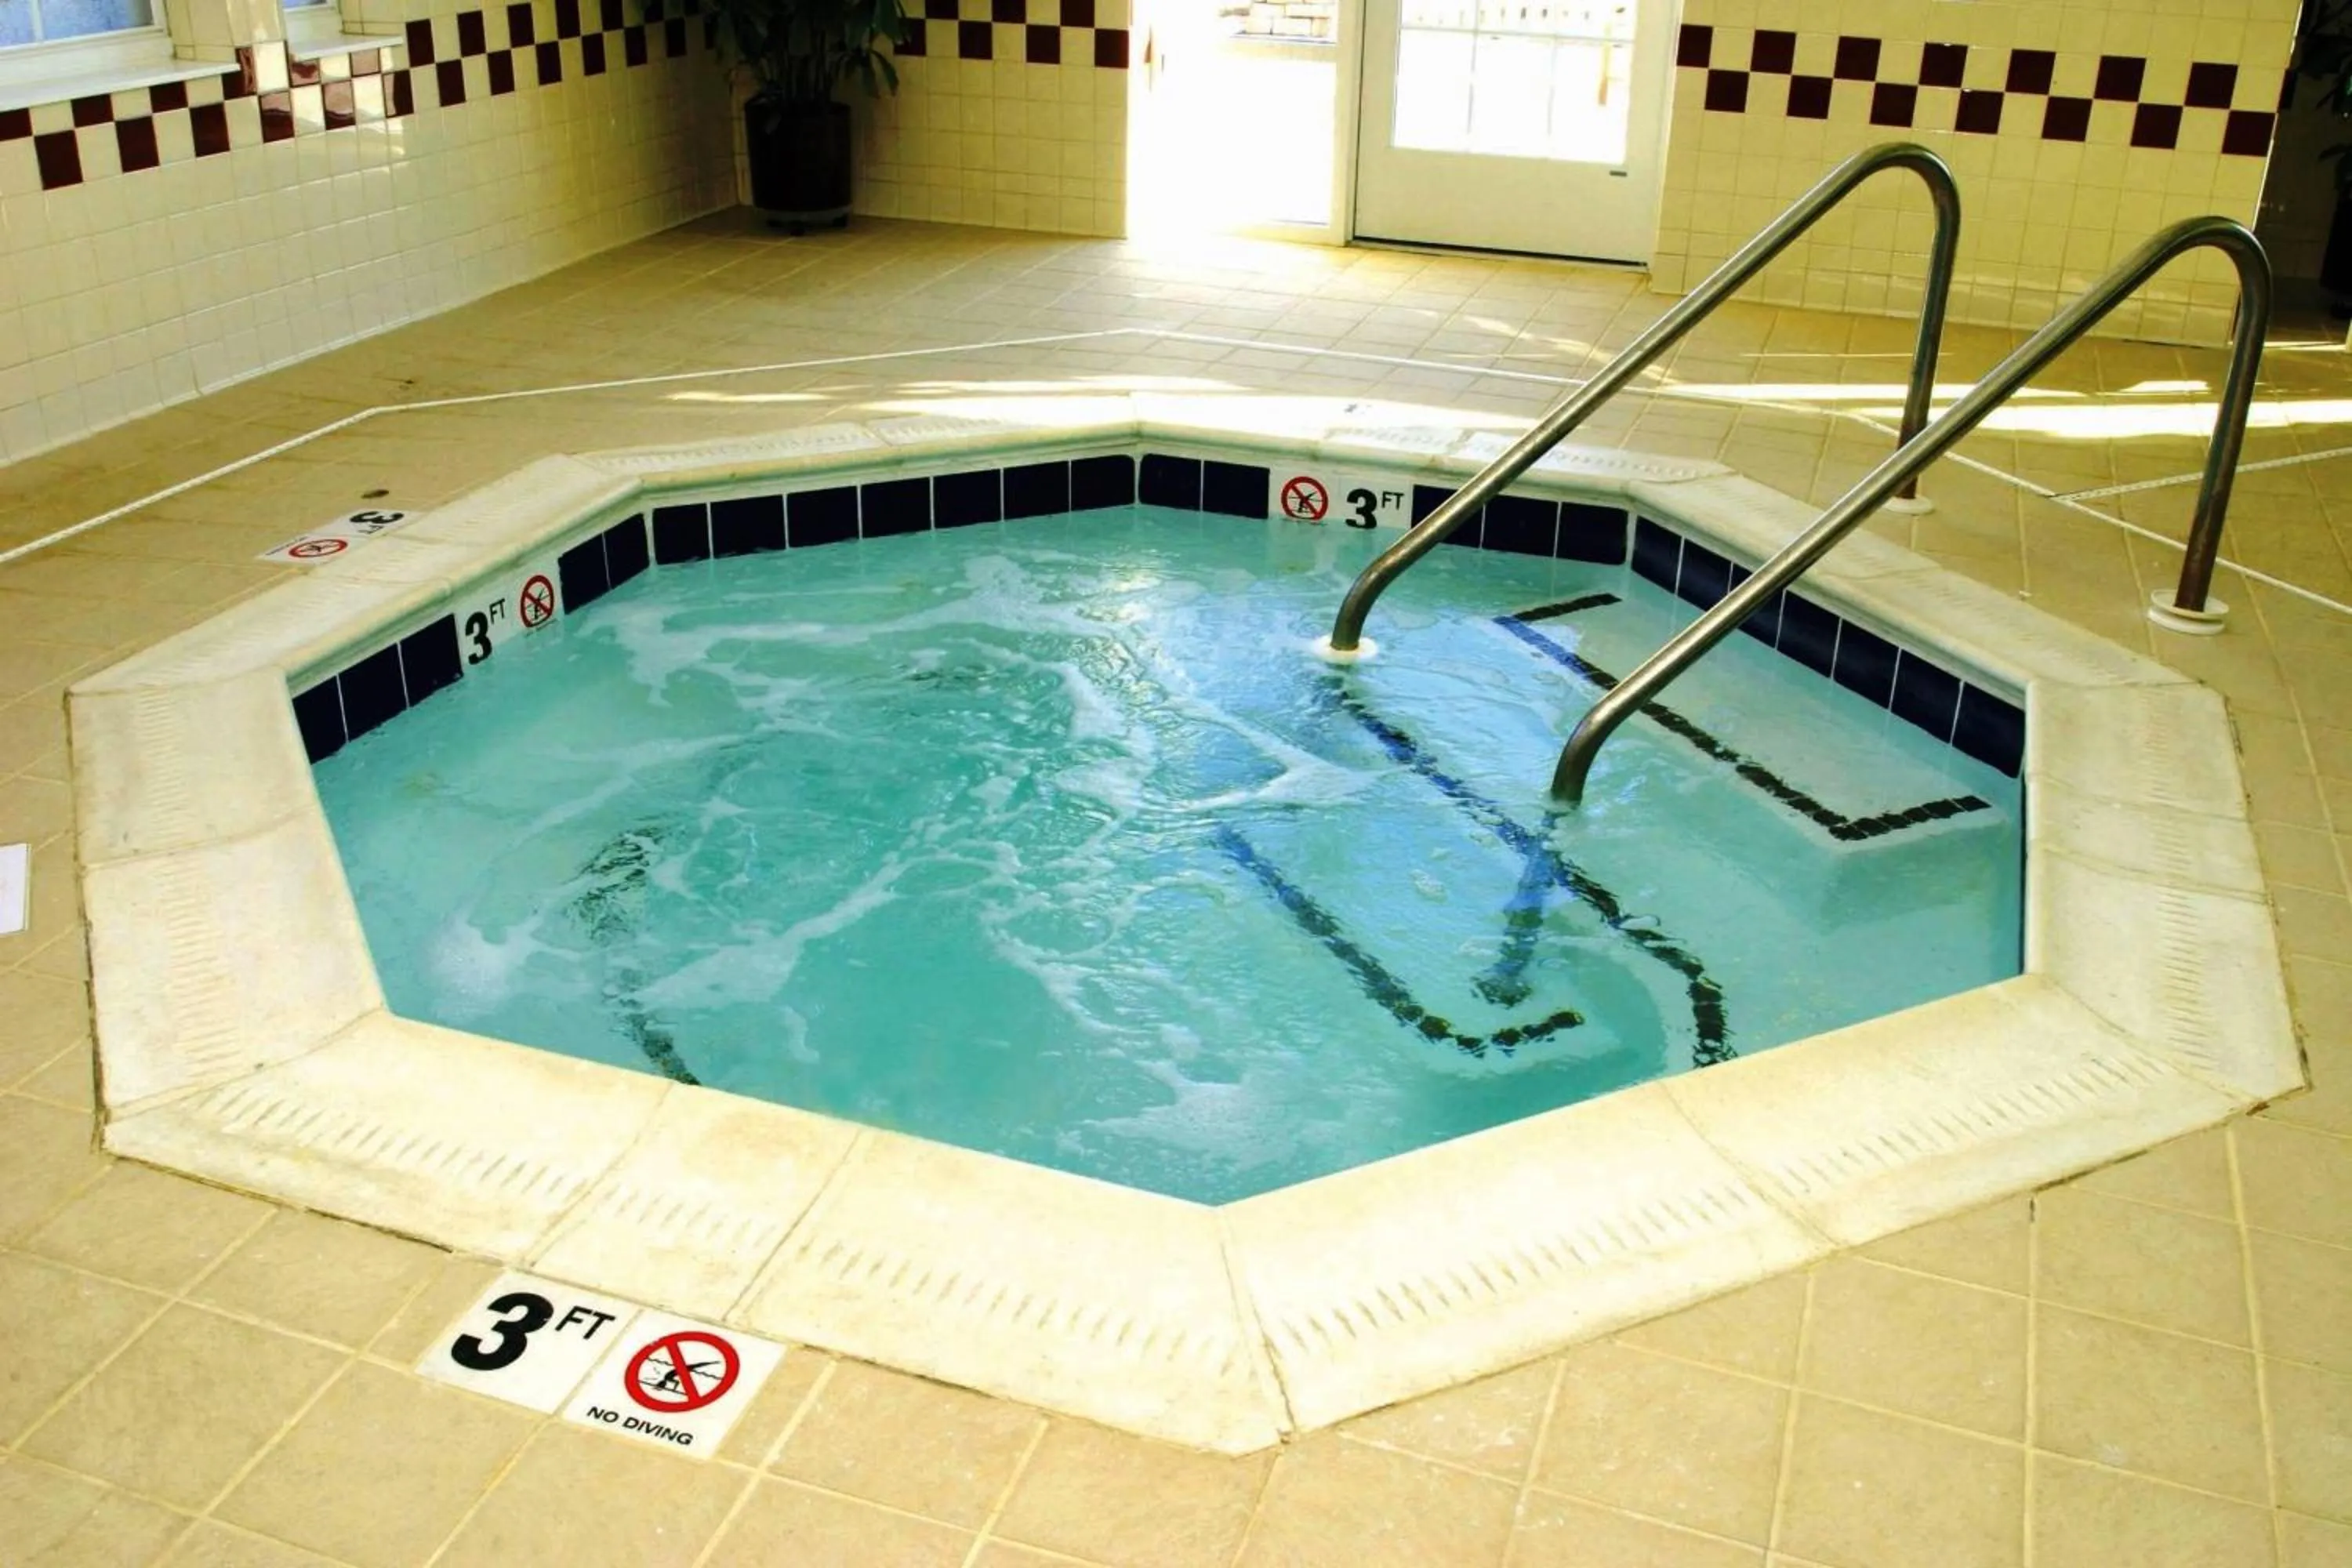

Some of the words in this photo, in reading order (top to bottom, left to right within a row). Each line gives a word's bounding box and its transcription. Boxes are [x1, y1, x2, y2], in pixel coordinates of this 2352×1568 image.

[1345, 488, 1377, 529] 3
[1381, 491, 1404, 510] FT
[465, 611, 492, 666] 3
[489, 598, 506, 624] FT
[451, 1292, 554, 1371] 3
[555, 1305, 615, 1340] FT
[586, 1406, 620, 1424] NO
[622, 1416, 694, 1446] DIVING
